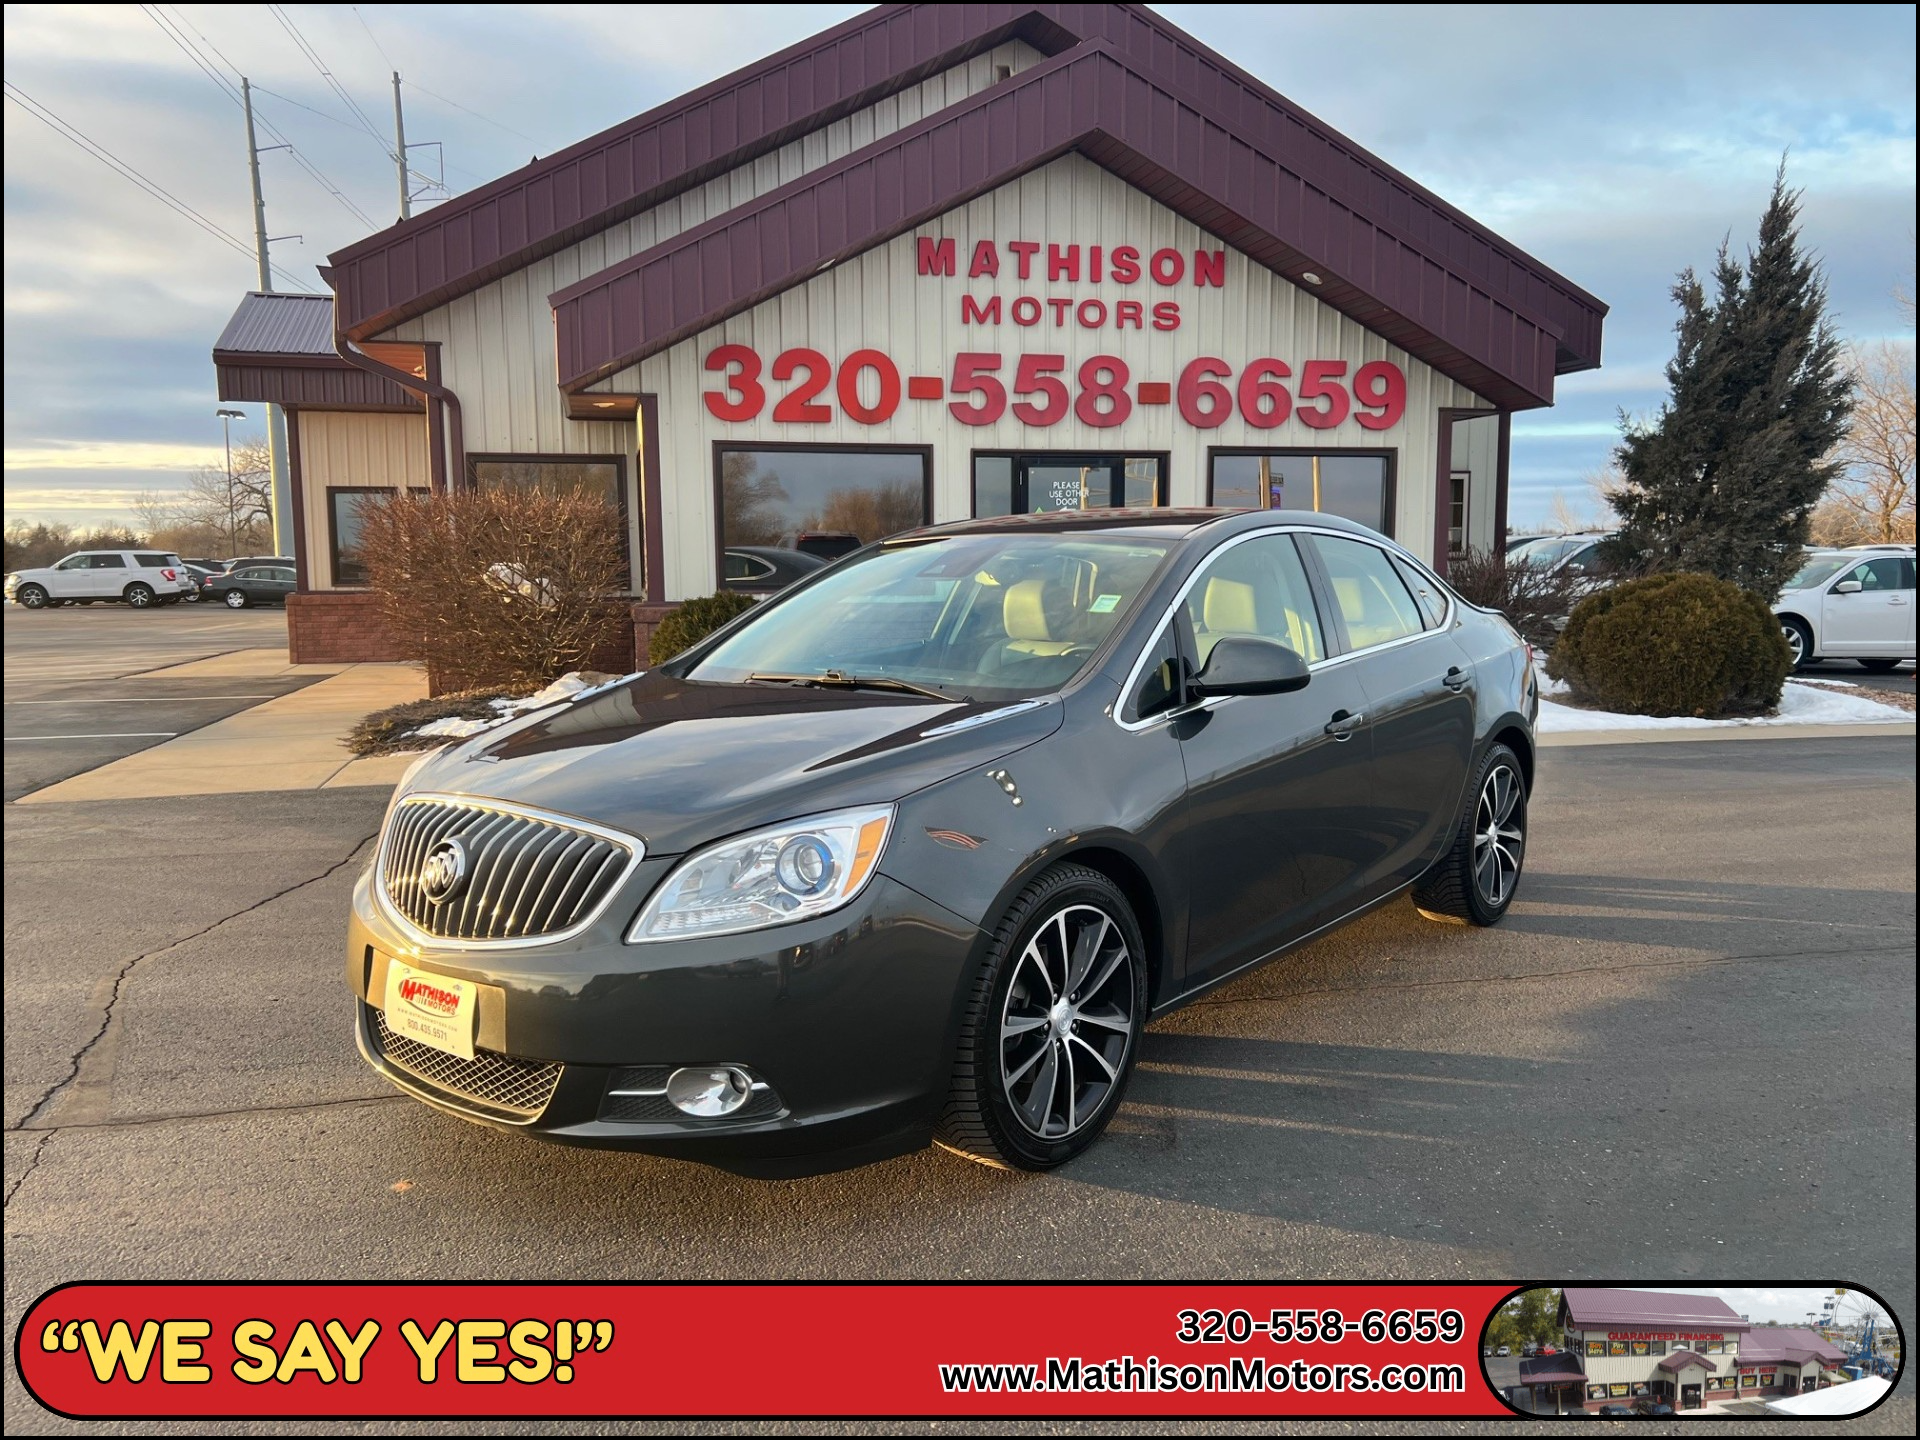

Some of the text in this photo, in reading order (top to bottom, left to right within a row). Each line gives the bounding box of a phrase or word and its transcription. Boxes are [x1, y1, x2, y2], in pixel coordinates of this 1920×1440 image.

[917, 236, 1226, 288] MATHISON
[961, 294, 1182, 331] MOTORS
[703, 343, 1407, 430] 320-558-6659
[1049, 489, 1089, 498] USE OTHER
[1053, 481, 1080, 489] PLEASE
[1055, 497, 1078, 506] DOOR
[401, 979, 460, 1008] MATHISON
[428, 1000, 456, 1015] MOTORS
